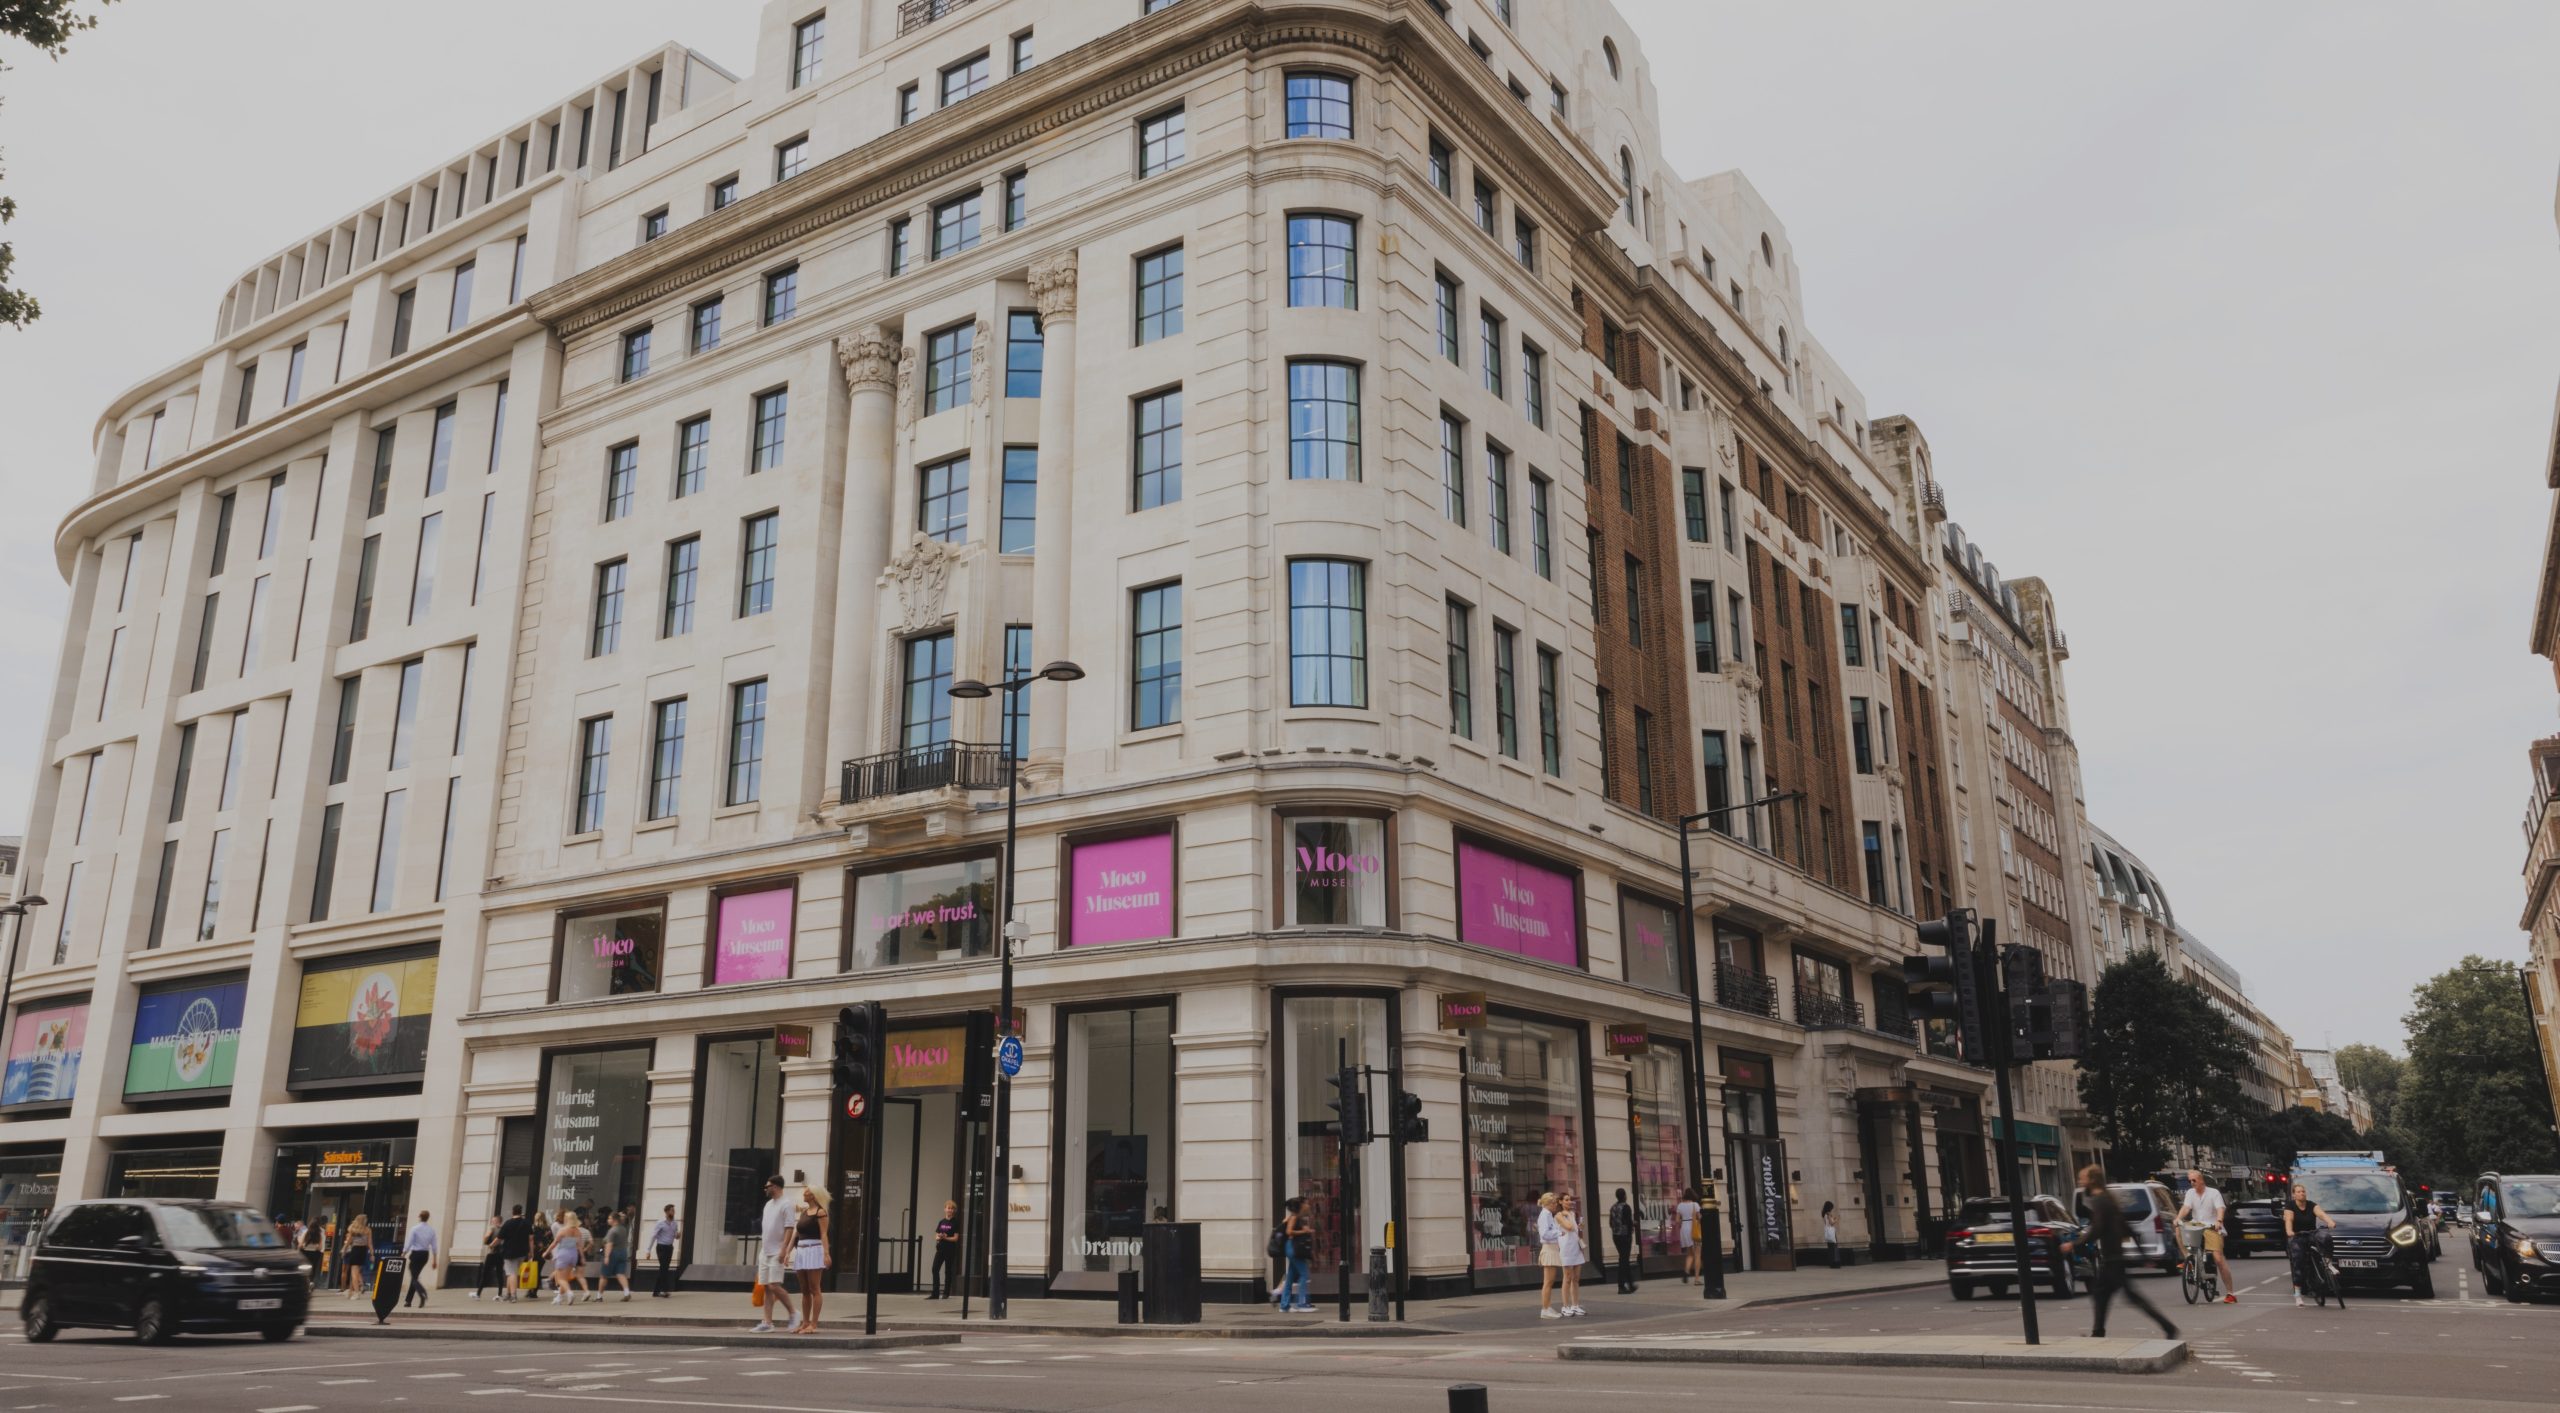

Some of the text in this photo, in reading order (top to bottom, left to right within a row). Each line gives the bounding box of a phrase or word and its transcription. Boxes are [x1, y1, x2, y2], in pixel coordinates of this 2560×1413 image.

[1295, 846, 1379, 874] Moco
[1099, 869, 1147, 889] Moco
[1501, 877, 1535, 906] Moco
[1084, 892, 1160, 914] Museum
[887, 911, 911, 929] art
[913, 910, 936, 925] we
[939, 901, 978, 923] trust.
[1491, 902, 1549, 937] Museum
[741, 919, 775, 935] Moco
[592, 934, 635, 959] Moco
[728, 939, 784, 955] Museum
[1446, 1004, 1481, 1016] Moco
[150, 1035, 175, 1048] MAKE
[778, 1033, 807, 1046] Moco
[1613, 1034, 1643, 1044] Moco
[891, 1043, 949, 1069] Moco
[1468, 1056, 1503, 1081] Haring
[556, 1089, 595, 1107] Haring
[1468, 1085, 1509, 1106] Kusama
[554, 1114, 600, 1129] Kusama
[1469, 1114, 1507, 1135] Warhol
[552, 1135, 594, 1152] Warhol
[1471, 1143, 1514, 1167] Basquiat
[320, 1165, 340, 1178] Local
[549, 1159, 599, 1180] Basquiat
[547, 1184, 576, 1200] Hirst
[1472, 1172, 1498, 1192] Hirst
[1472, 1203, 1502, 1222] Kaws
[1067, 1235, 1143, 1256] Abramo
[1474, 1231, 1507, 1252] Koons
